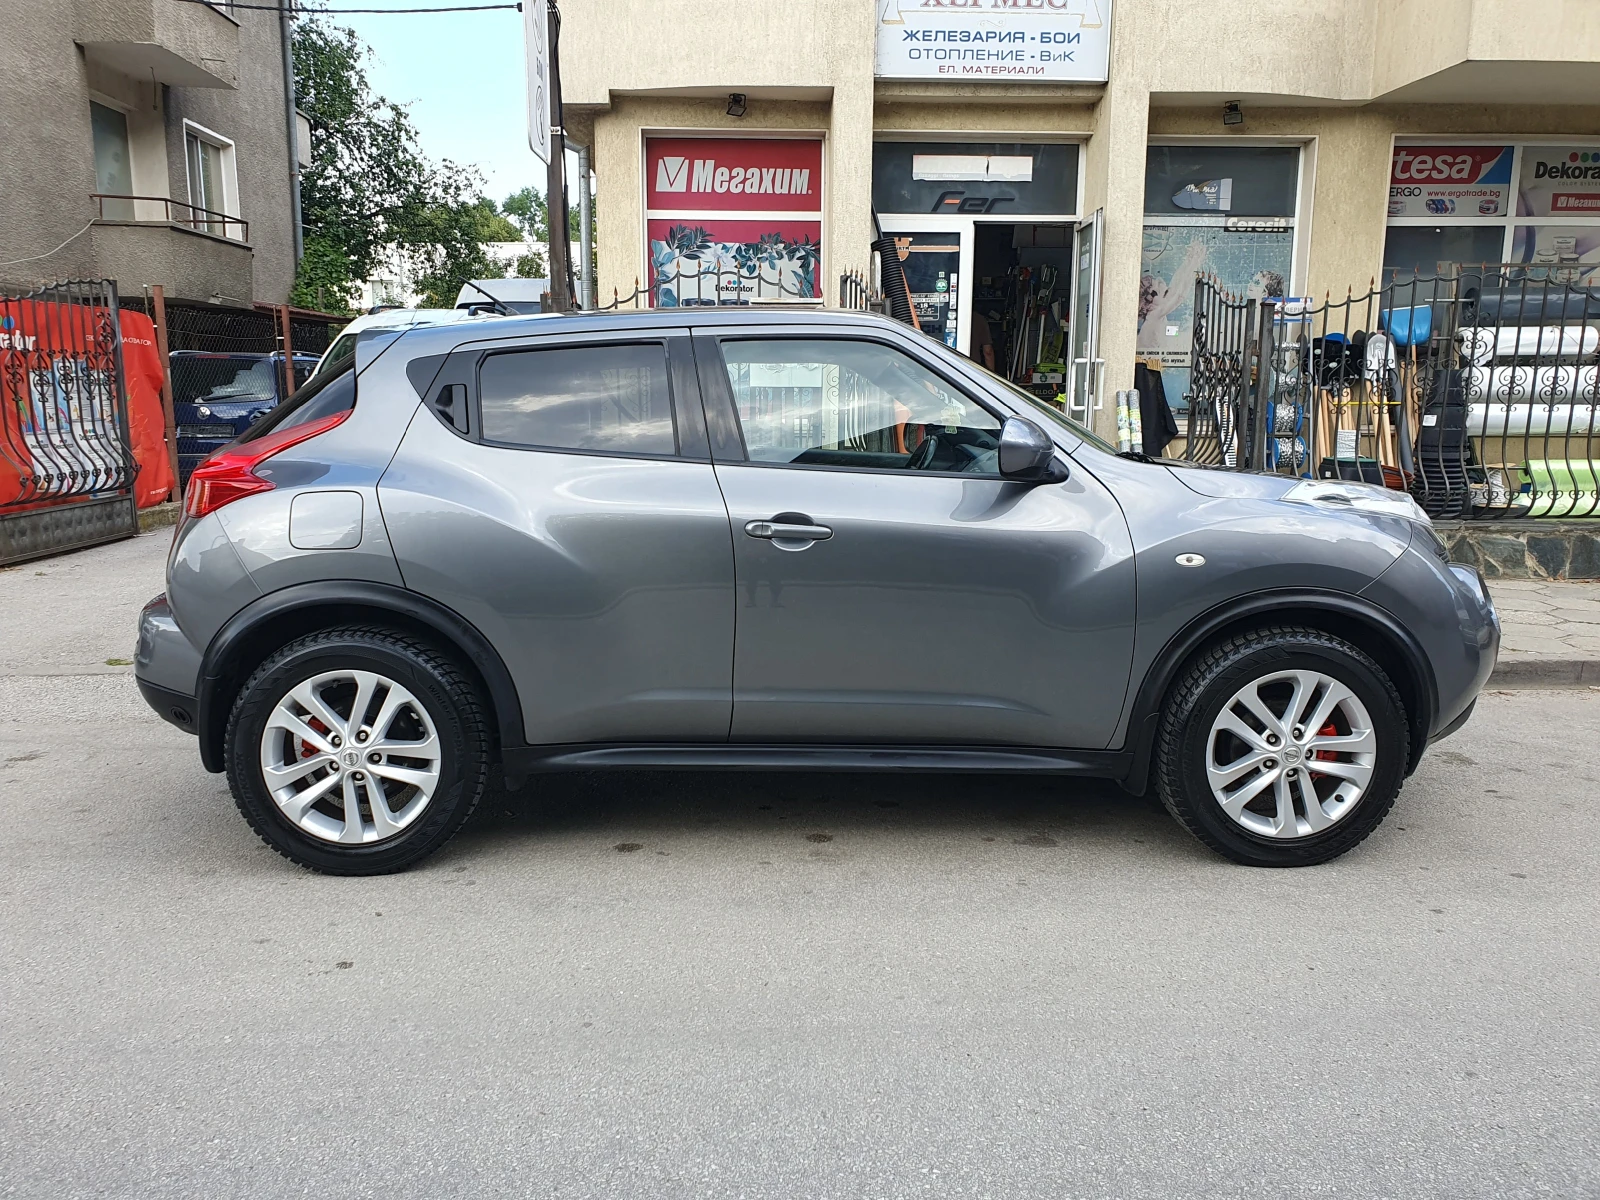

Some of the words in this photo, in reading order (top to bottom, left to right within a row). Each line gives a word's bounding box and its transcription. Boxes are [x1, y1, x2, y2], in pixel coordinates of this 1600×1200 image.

[902, 30, 1025, 43] ЖЕЛЕЗАРИЯ
[1040, 32, 1080, 44] БОИ
[908, 48, 1025, 61] ОТОПЛЕНИЕ
[1040, 50, 1075, 62] ВиК
[938, 65, 958, 73] ЕЛ.
[962, 65, 1045, 75] МАТЕРИАЛИ
[1427, 188, 1501, 198] www.ergotrade.bg
